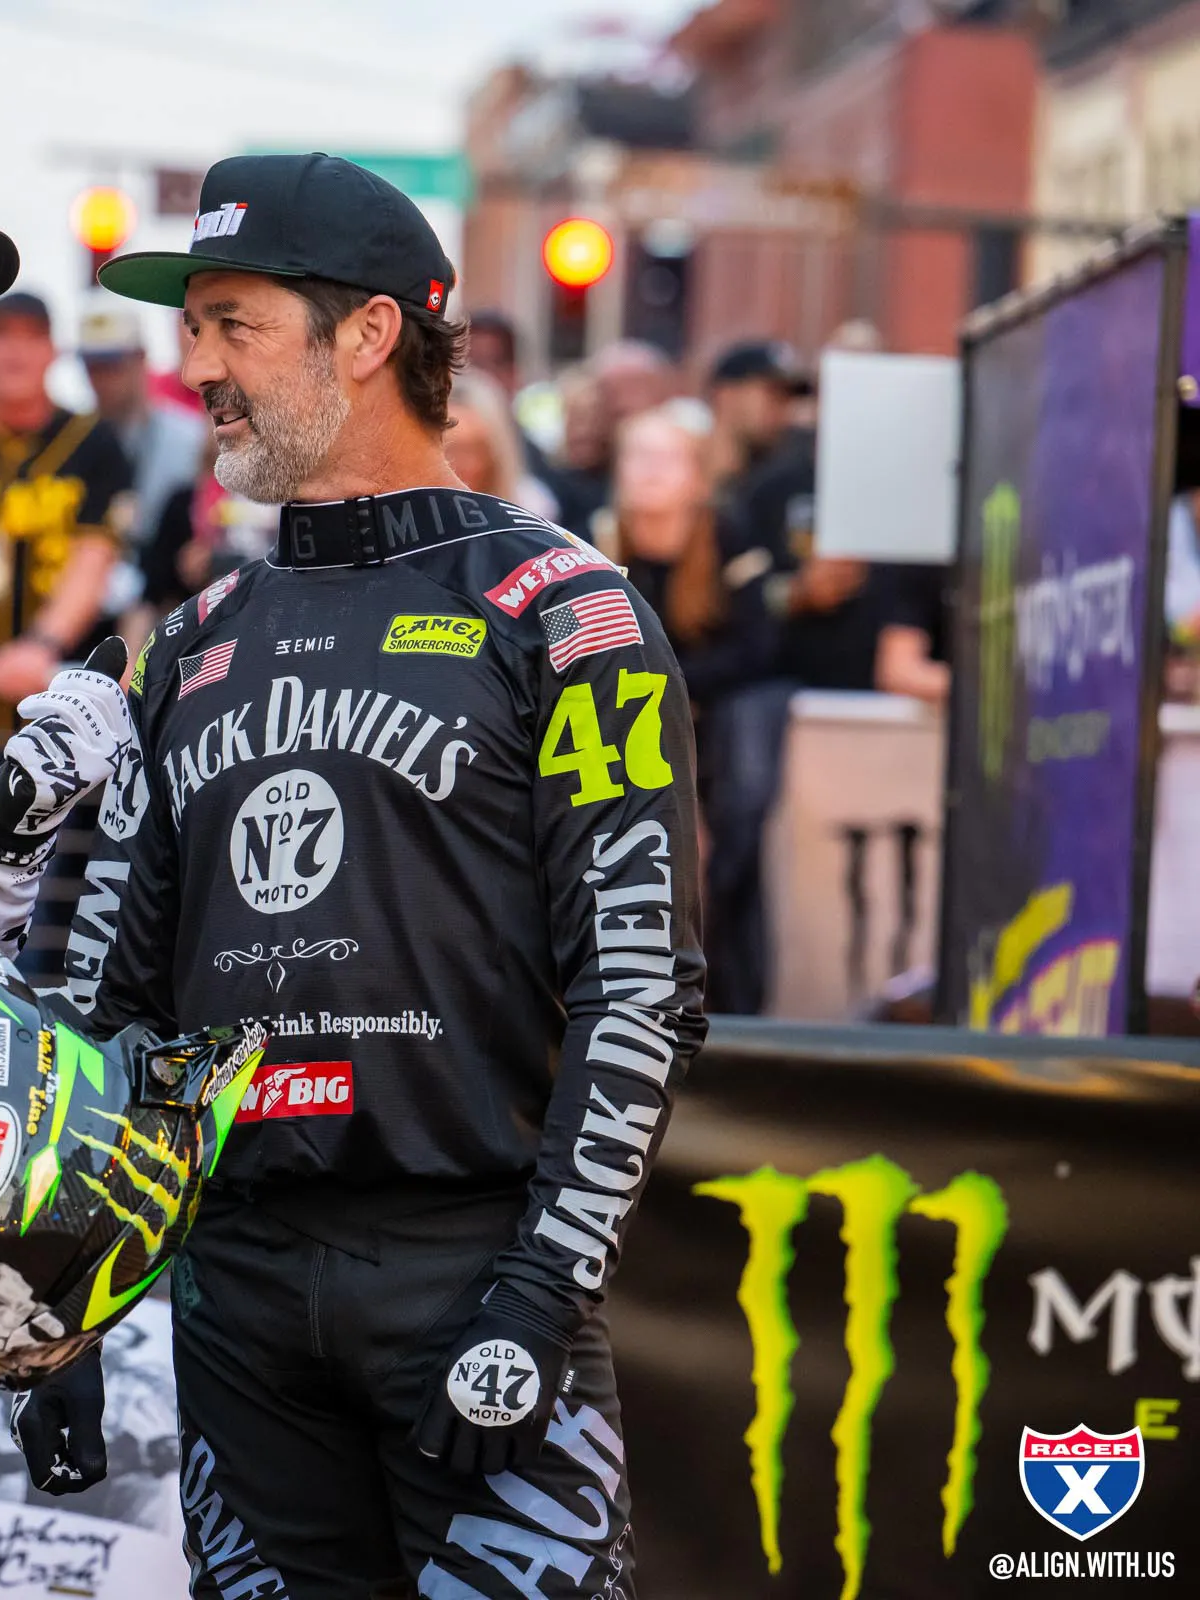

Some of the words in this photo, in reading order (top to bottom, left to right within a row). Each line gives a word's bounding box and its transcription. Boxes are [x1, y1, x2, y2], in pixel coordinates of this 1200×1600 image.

[497, 571, 542, 609] WE
[294, 635, 336, 653] EMIG
[390, 618, 482, 644] CAMEL
[388, 639, 476, 655] SMOKERCROSS
[538, 668, 674, 807] 47
[162, 702, 257, 833] JACK
[262, 676, 479, 801] DANIEL'S
[266, 779, 311, 804] OLD
[254, 883, 309, 905] MOTO
[582, 819, 684, 1089] DANIEL'S
[263, 1012, 314, 1037] rink
[319, 1010, 444, 1041] Responsibly.
[287, 1075, 350, 1106] BIG
[533, 1082, 664, 1291] JACK
[480, 1344, 516, 1360] OLD
[471, 1363, 535, 1411] 47
[469, 1407, 512, 1422] MOTO
